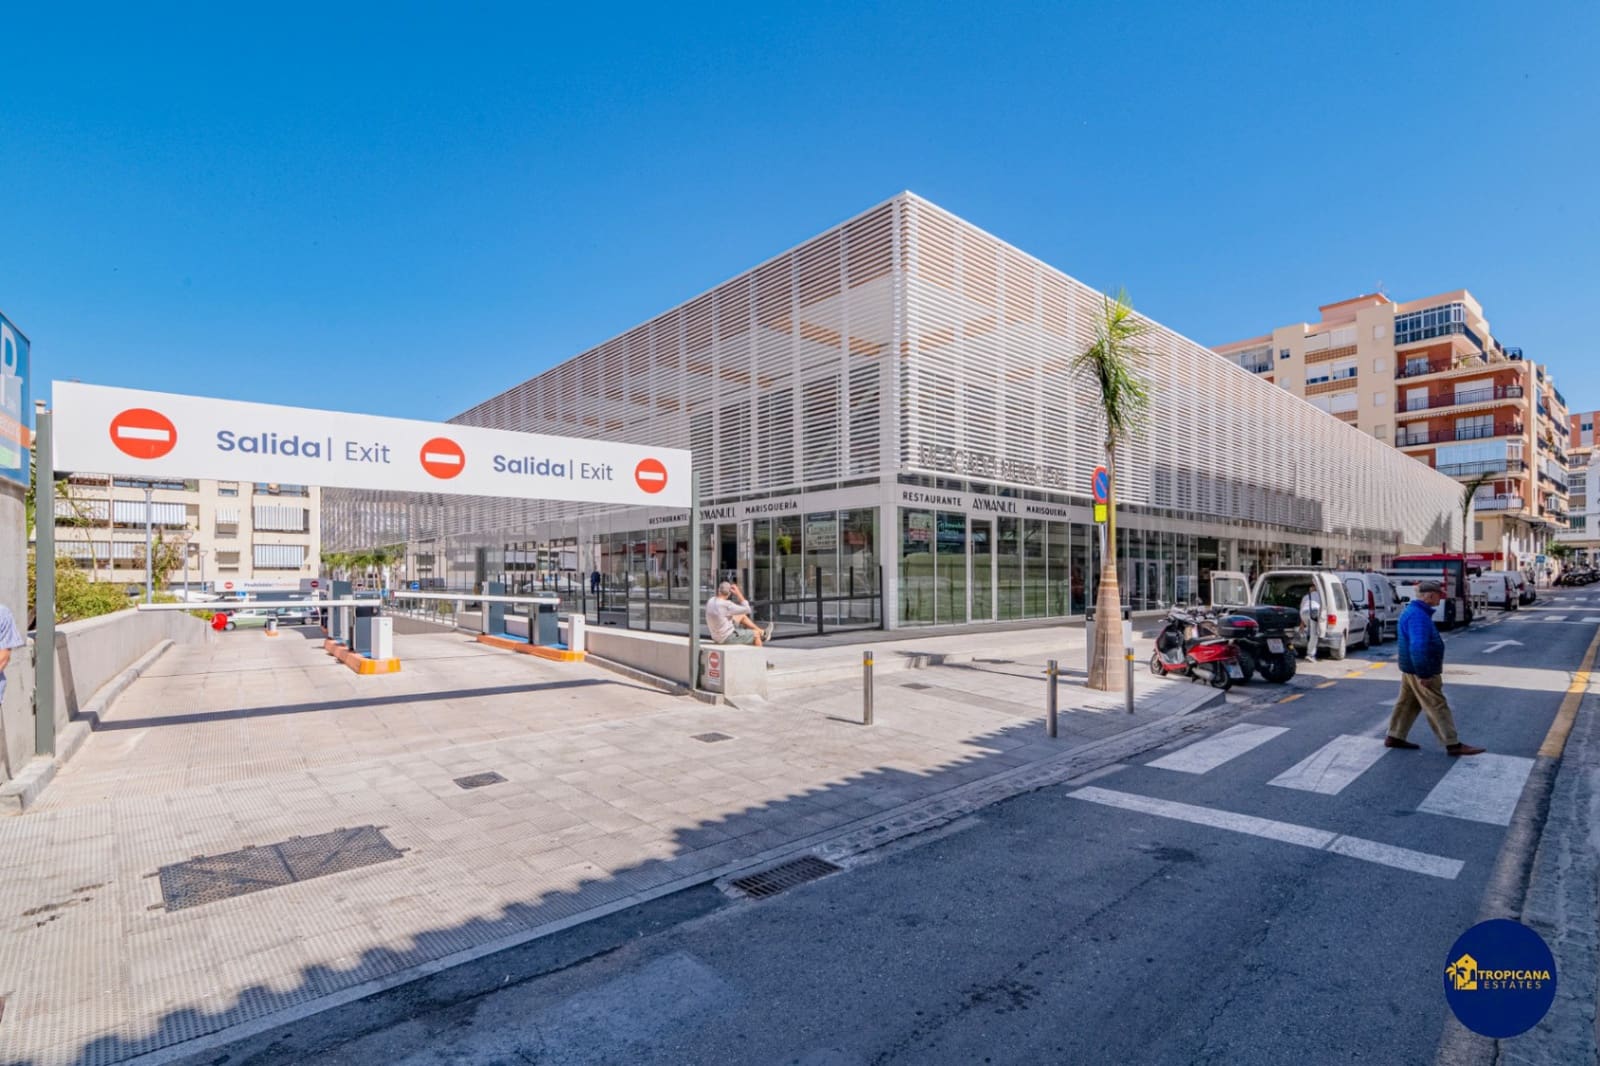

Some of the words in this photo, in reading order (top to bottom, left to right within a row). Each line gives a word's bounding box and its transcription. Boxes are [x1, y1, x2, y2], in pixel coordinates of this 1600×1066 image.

[216, 430, 321, 458] Salida
[345, 441, 391, 464] Exit
[493, 454, 565, 477] Salida
[580, 462, 613, 481] Exit
[648, 512, 688, 526] RESTAURANTE
[745, 499, 798, 514] MARISQUERÍA
[902, 490, 962, 507] RESTAURANTE
[972, 496, 1018, 514] AYMANUEL
